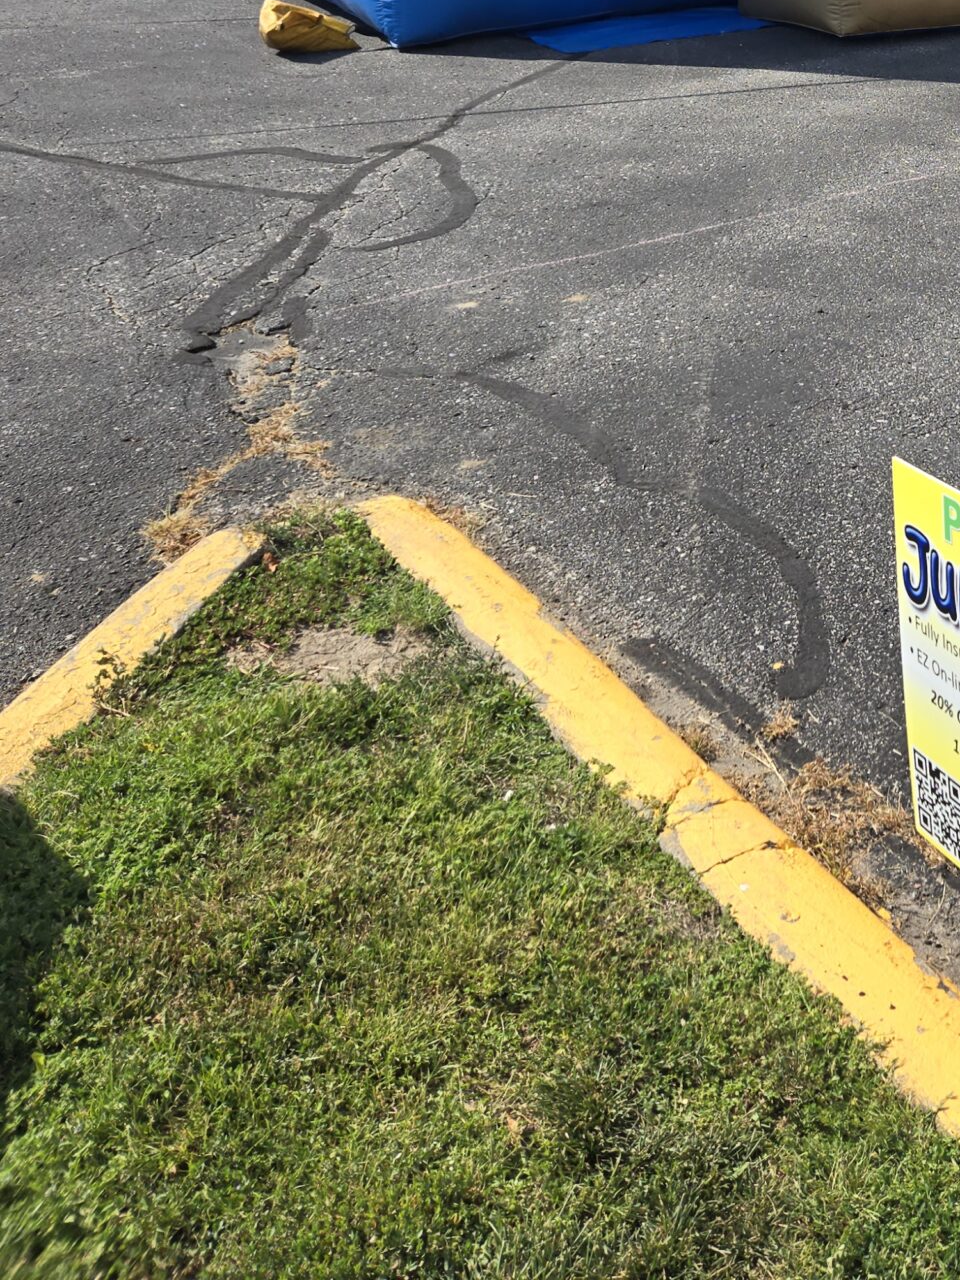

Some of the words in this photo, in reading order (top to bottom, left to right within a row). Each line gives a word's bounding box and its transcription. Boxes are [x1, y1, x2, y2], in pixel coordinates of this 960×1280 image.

[915, 615, 940, 647] Fully
[917, 648, 930, 671] EZ
[931, 690, 954, 718] 20%
